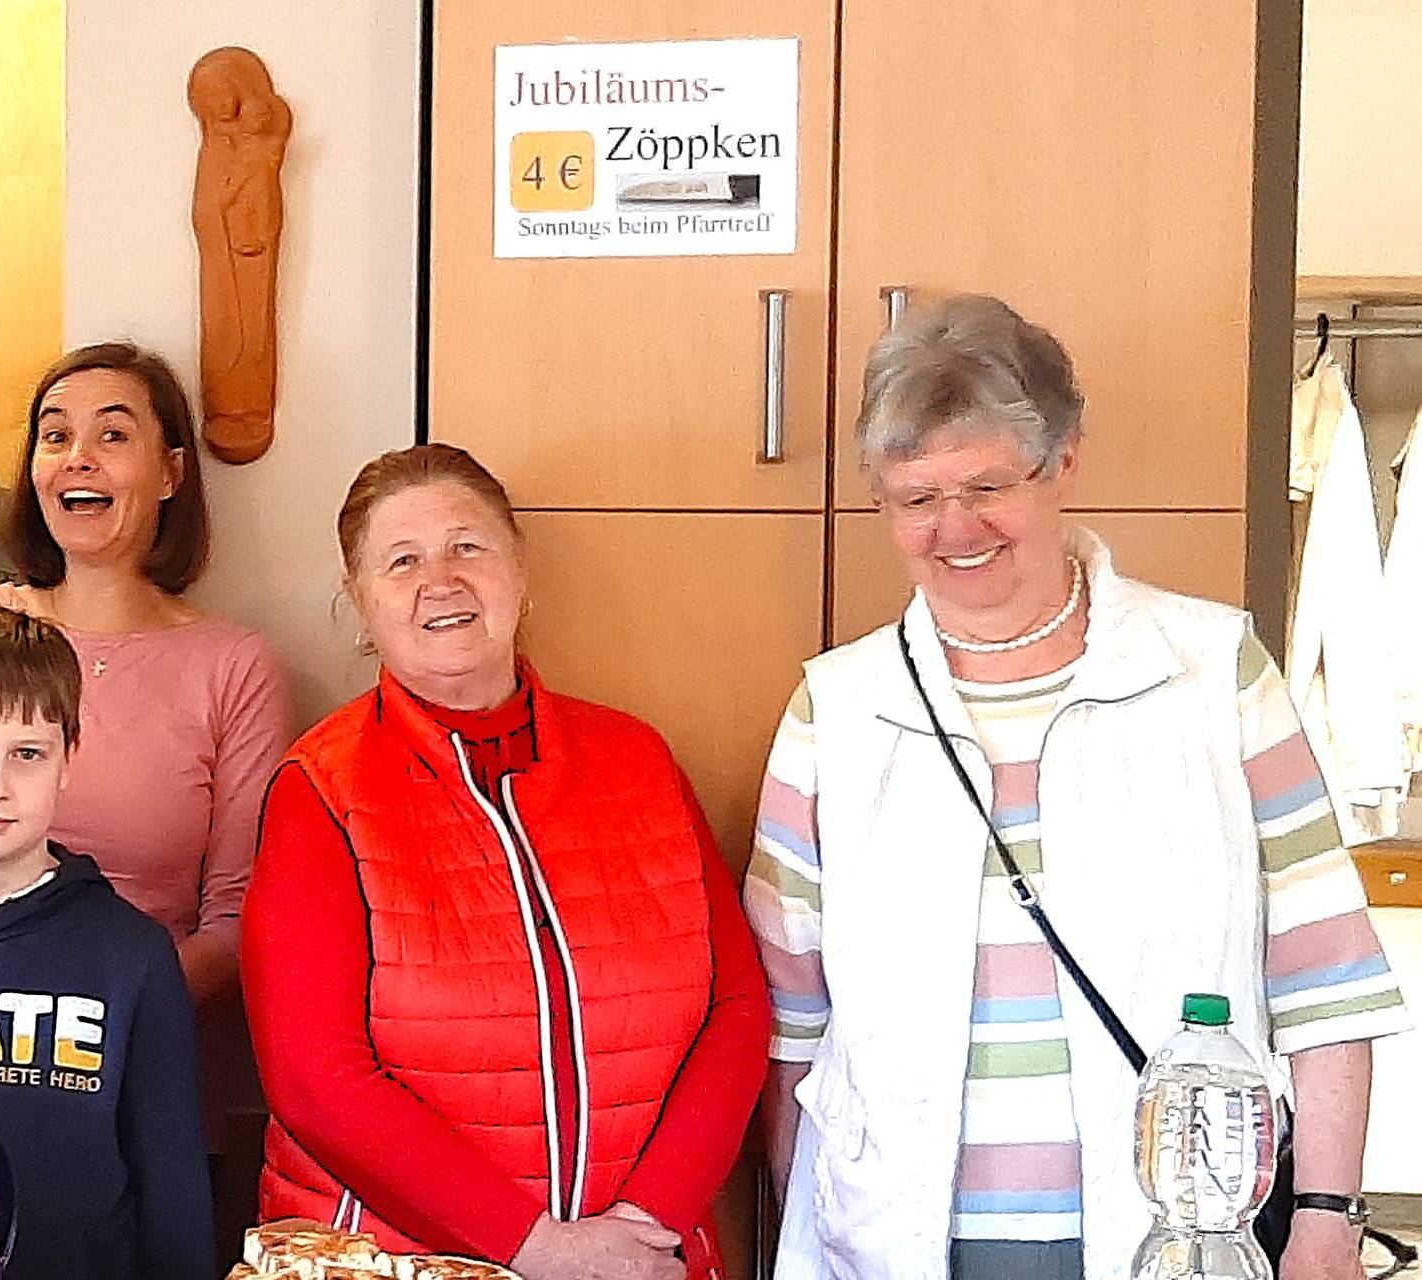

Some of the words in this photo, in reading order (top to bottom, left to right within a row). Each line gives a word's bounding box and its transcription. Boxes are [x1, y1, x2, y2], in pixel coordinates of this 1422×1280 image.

[510, 69, 725, 106] Jubiläums-
[605, 123, 781, 170] Zöppken
[522, 156, 545, 191] 4
[560, 155, 583, 190] €
[518, 217, 611, 240] Sonntags
[618, 216, 668, 235] beim
[49, 1070, 101, 1092] HERO
